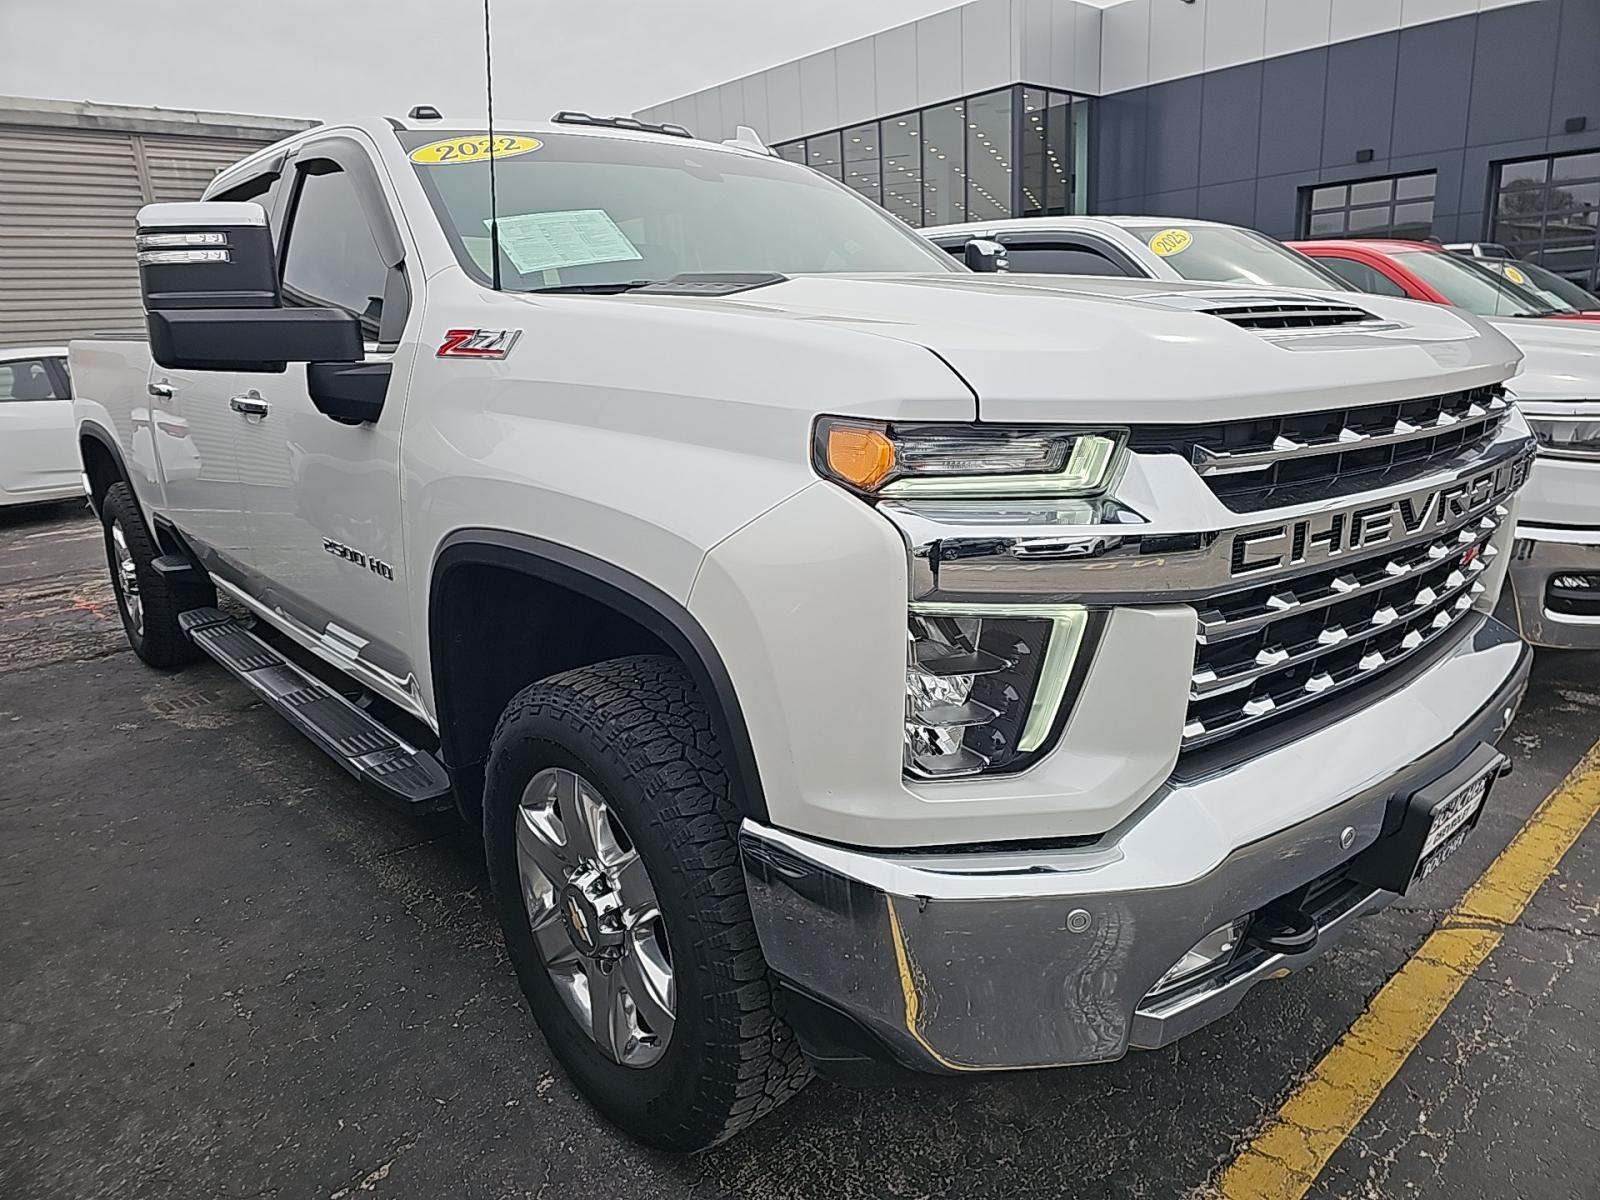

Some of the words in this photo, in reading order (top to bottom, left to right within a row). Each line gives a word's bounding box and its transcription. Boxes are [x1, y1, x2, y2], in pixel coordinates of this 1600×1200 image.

[436, 138, 520, 161] 2022
[1157, 231, 1187, 252] 2025
[435, 329, 523, 360] Z71
[1231, 450, 1536, 578] CHEVROLET
[322, 536, 366, 568] 2500
[368, 555, 393, 581] HD
